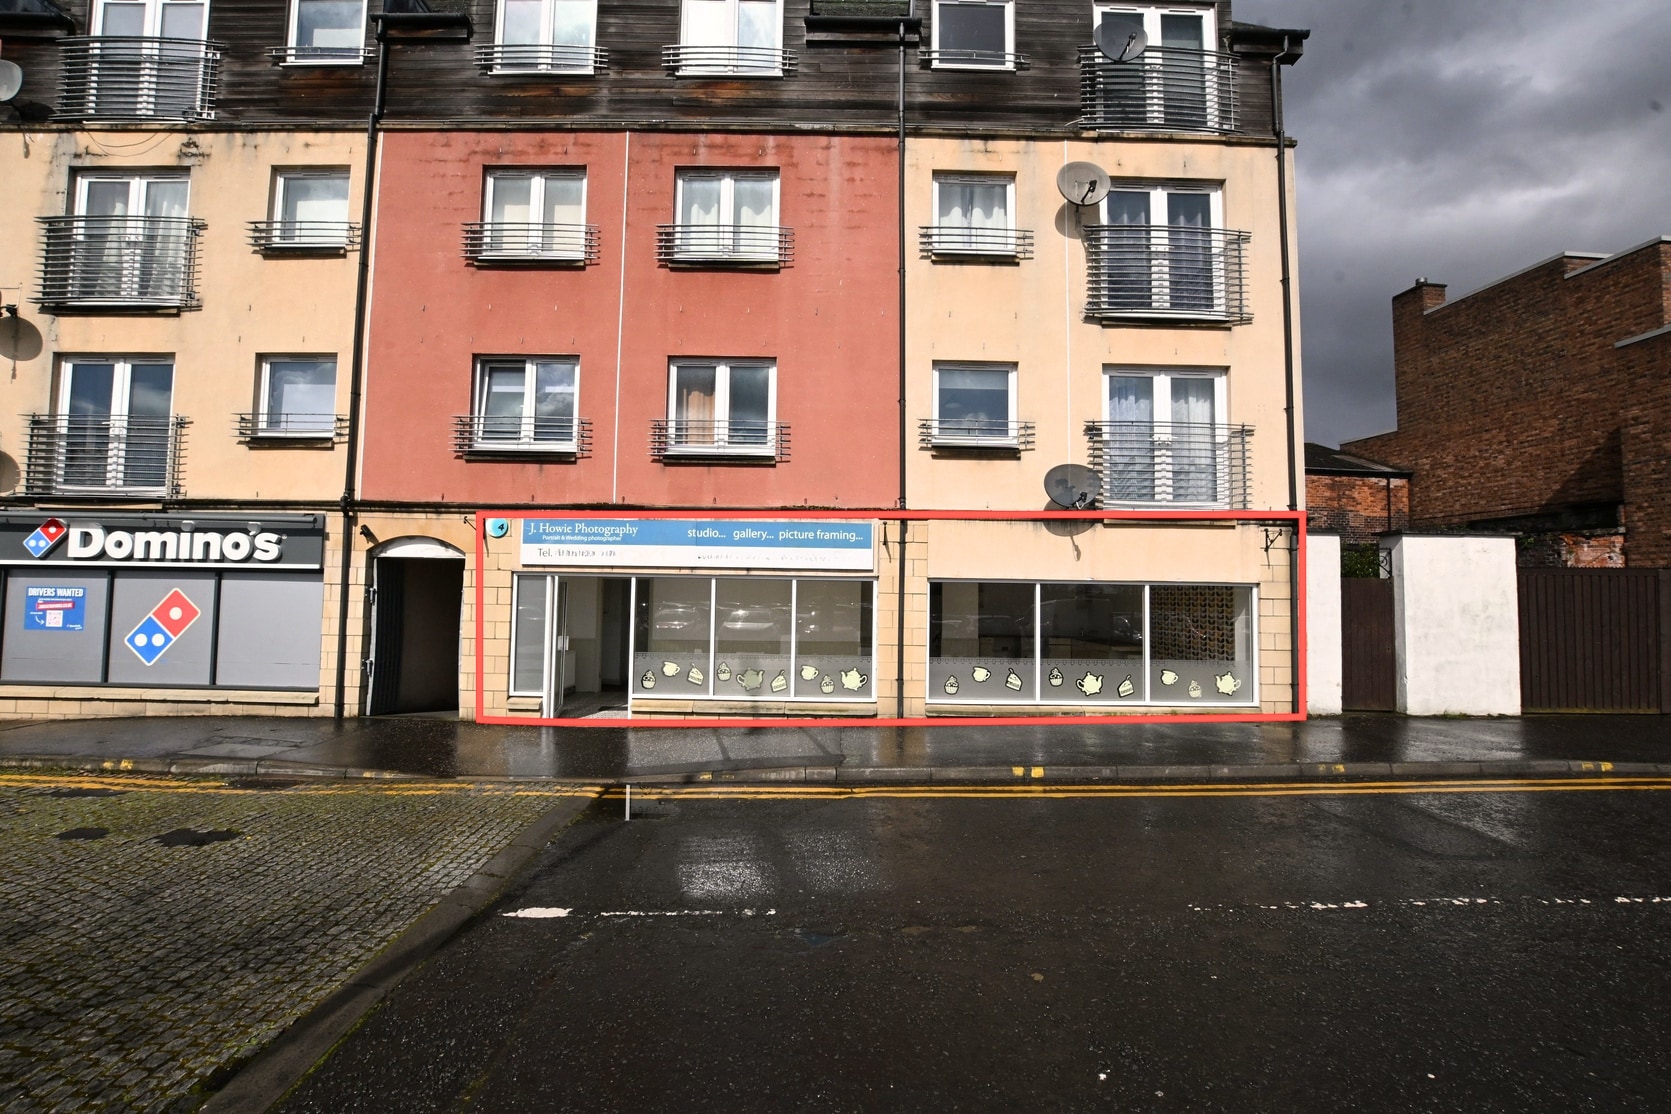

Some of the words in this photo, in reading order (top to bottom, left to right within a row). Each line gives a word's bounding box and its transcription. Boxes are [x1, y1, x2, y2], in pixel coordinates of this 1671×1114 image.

[528, 523, 537, 535] J.
[540, 523, 573, 534] Howie
[575, 523, 639, 537] Photography
[687, 528, 726, 538] studio...
[733, 528, 774, 541] gallery...
[779, 529, 815, 541] picture
[816, 530, 864, 542] framing...
[66, 520, 283, 561] Domino's
[537, 547, 553, 558] Tel.
[28, 587, 56, 596] DRIVERS
[56, 588, 84, 597] WANTED
